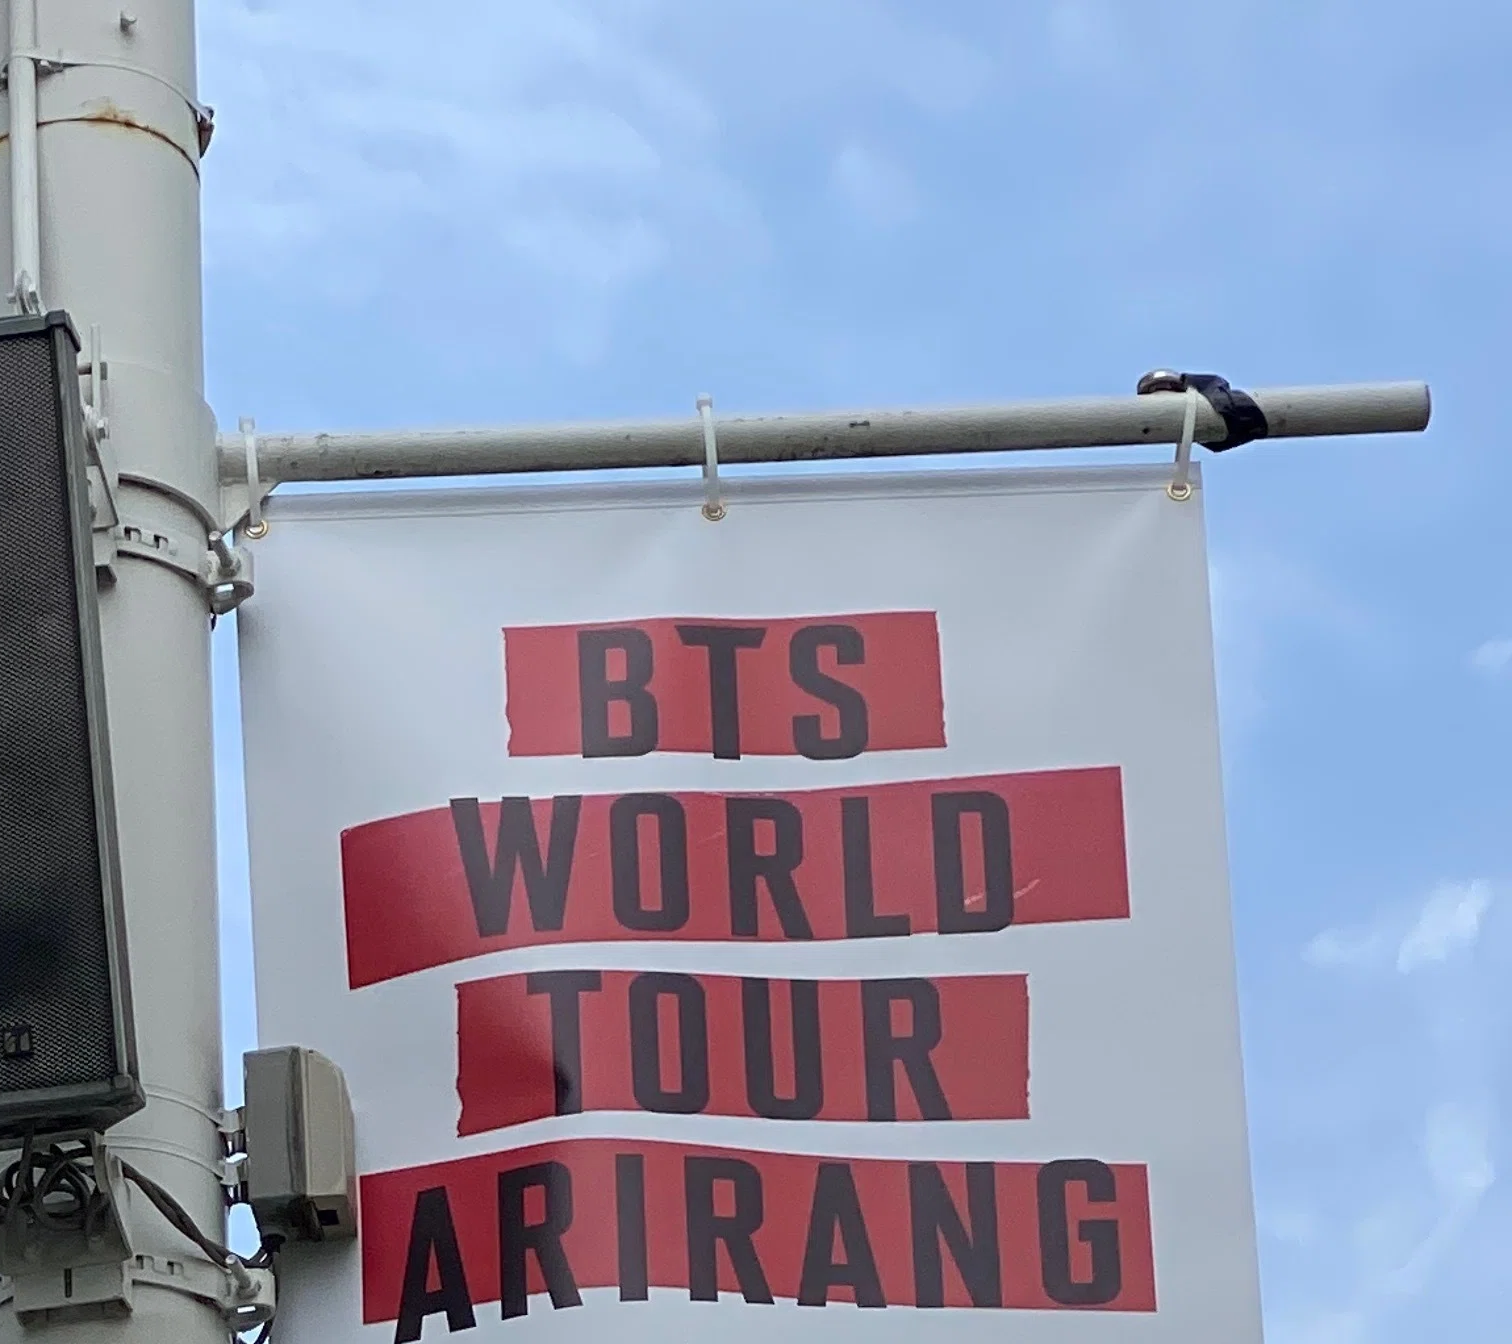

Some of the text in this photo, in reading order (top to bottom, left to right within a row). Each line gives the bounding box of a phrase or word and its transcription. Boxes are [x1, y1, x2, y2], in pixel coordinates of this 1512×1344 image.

[577, 624, 869, 760] BTS
[449, 791, 1014, 940] WORLD
[527, 970, 953, 1122] TOUR
